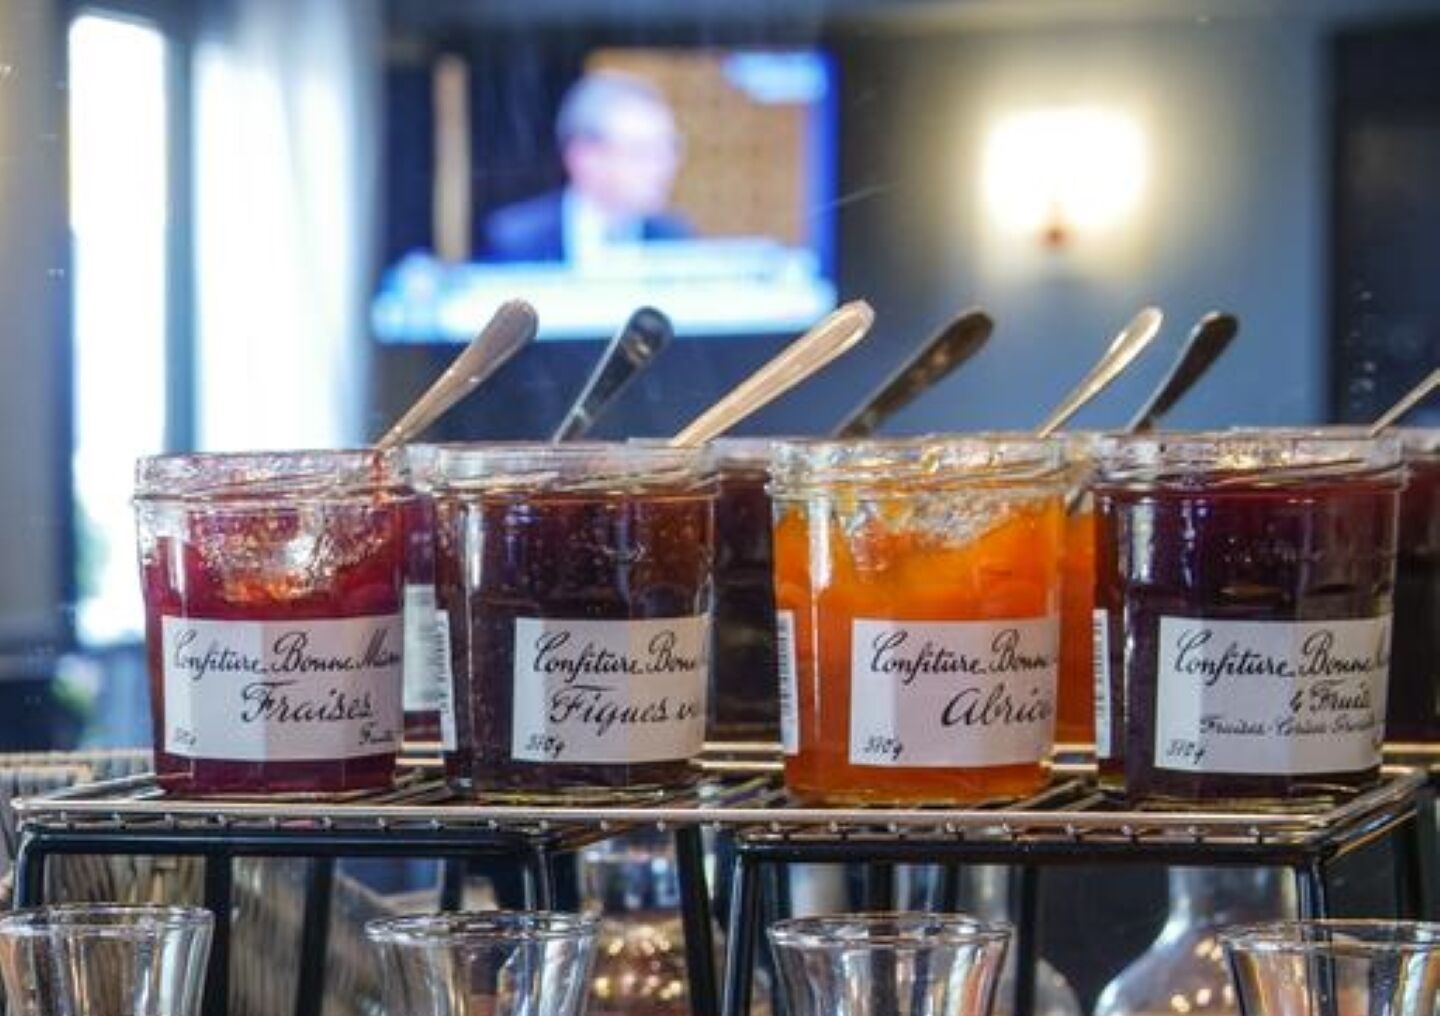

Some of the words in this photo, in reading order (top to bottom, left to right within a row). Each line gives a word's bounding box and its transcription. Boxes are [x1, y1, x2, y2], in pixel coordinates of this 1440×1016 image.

[173, 629, 266, 680] Confiture
[271, 629, 353, 673] Bonne
[533, 631, 643, 683] Confiture
[870, 630, 986, 685] Confiture
[1173, 629, 1296, 686] Confiture
[1299, 628, 1373, 675] Bonne
[241, 680, 373, 722] Fraises
[550, 684, 669, 737] Figues
